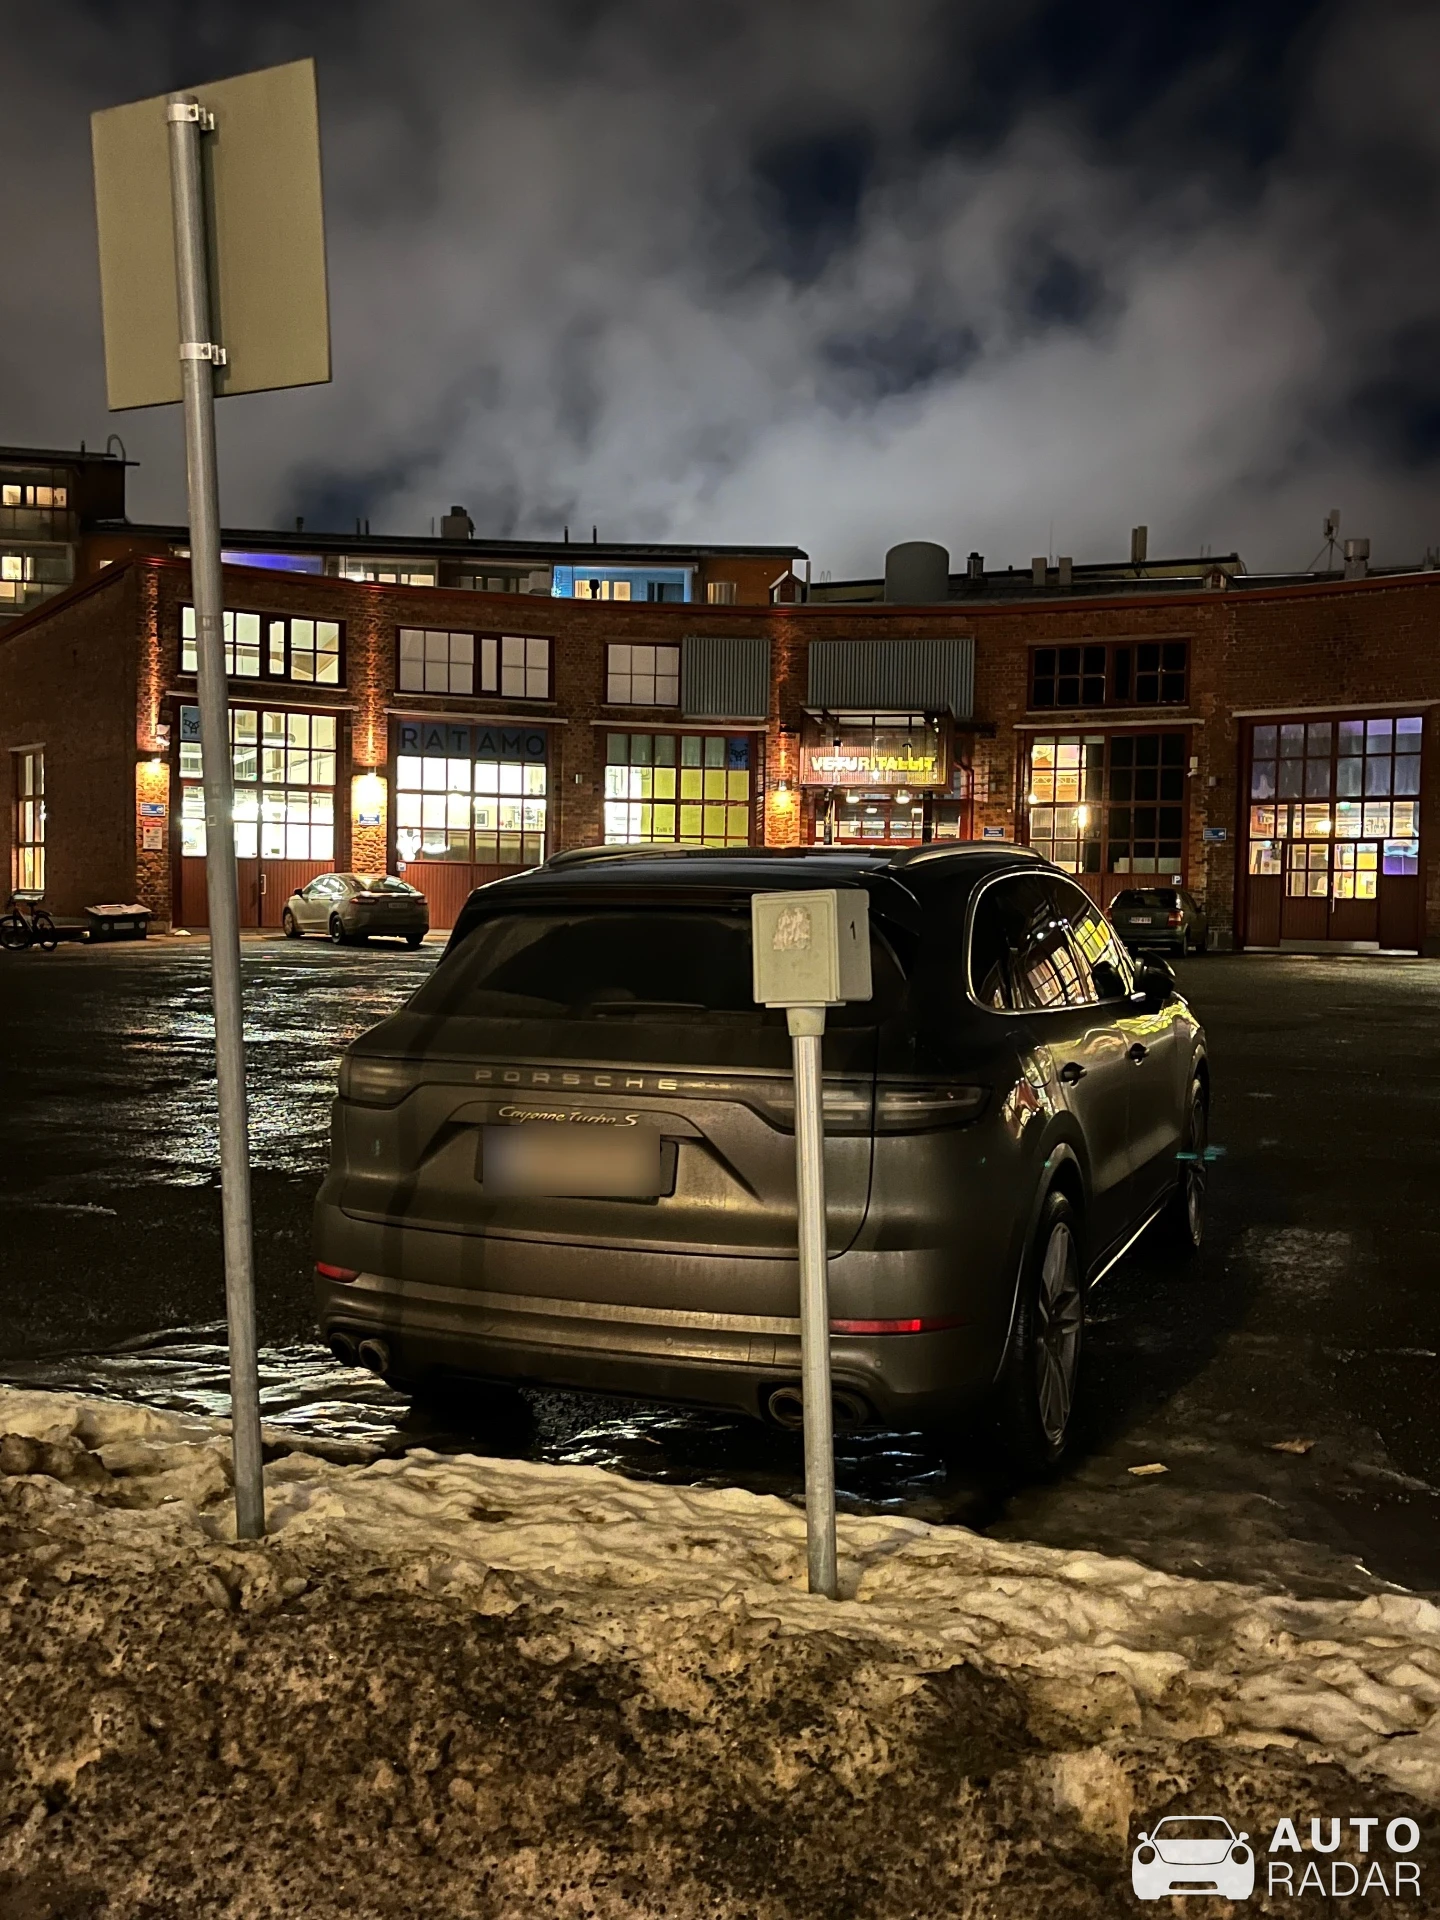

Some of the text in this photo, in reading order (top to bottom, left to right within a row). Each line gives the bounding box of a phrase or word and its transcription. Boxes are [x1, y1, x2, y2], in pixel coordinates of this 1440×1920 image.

[401, 727, 545, 755] RATAMO
[811, 756, 936, 772] VETURITALLIT
[1174, 875, 1181, 884] P
[850, 920, 856, 940] 1
[475, 1070, 678, 1091] PORSCHE
[498, 1106, 640, 1127] Cayenne Turbo S
